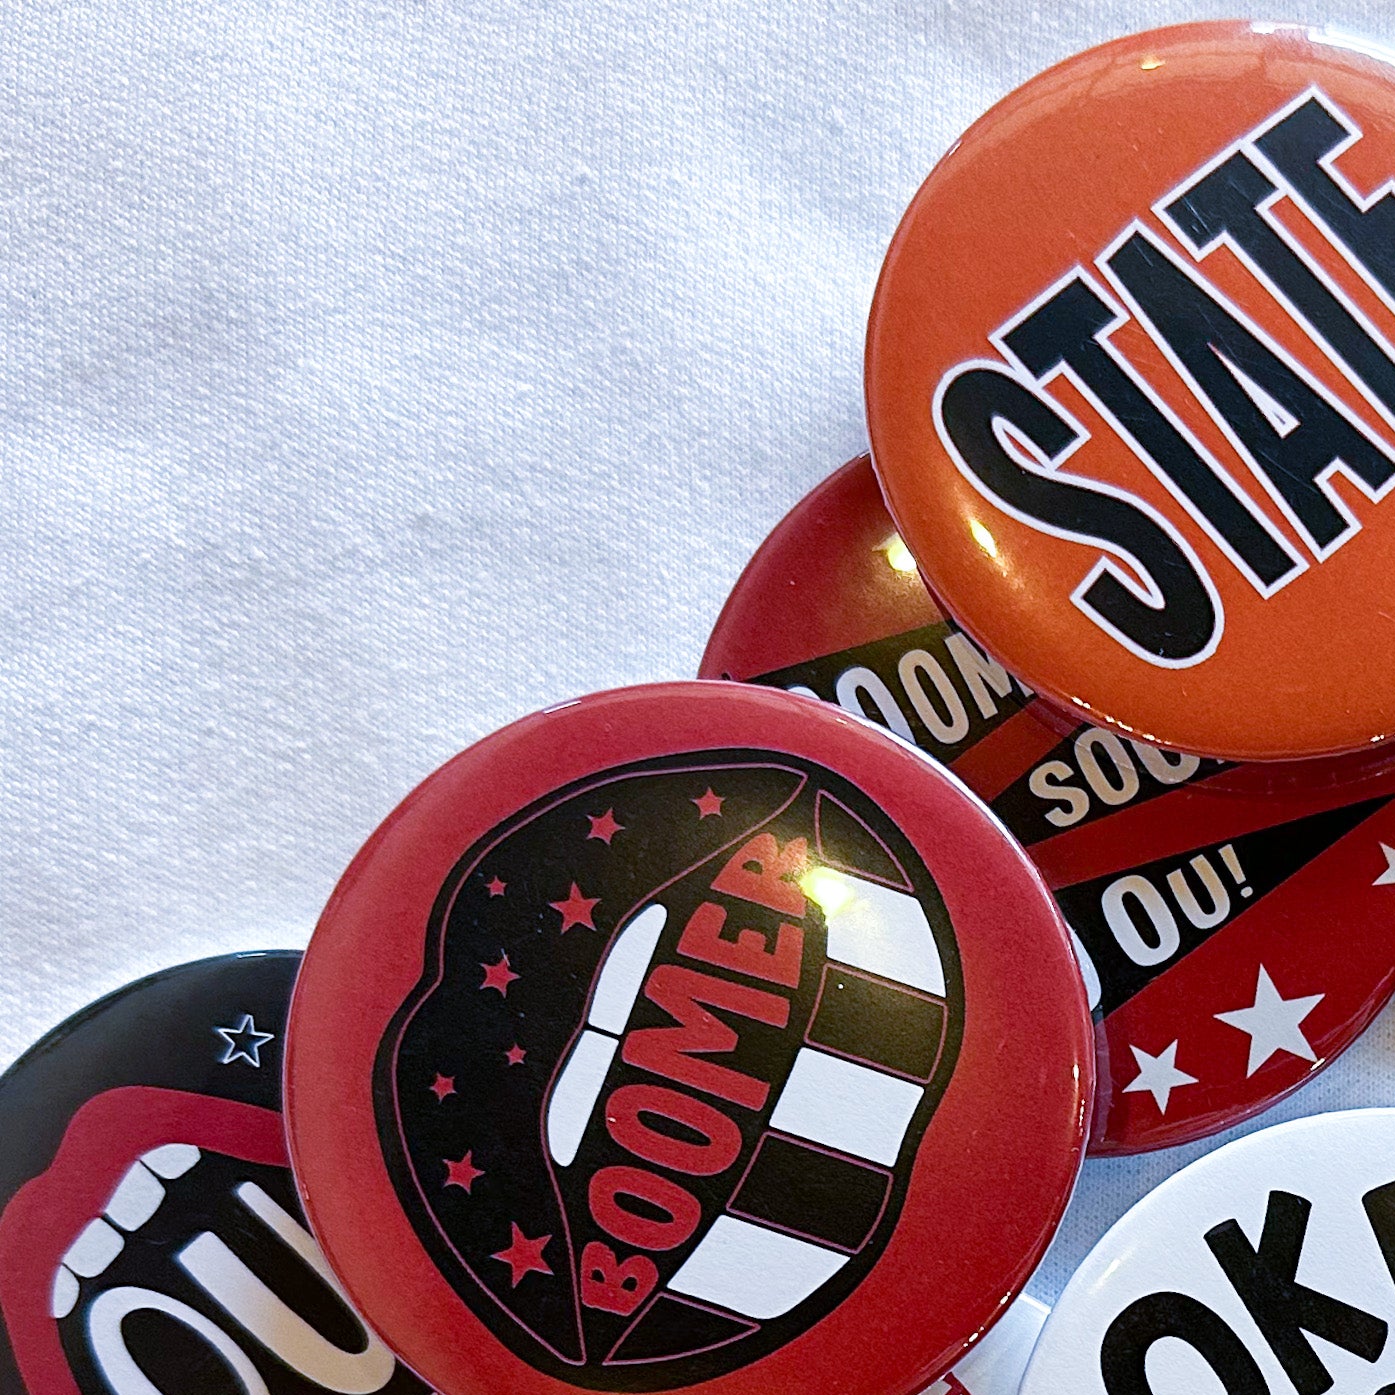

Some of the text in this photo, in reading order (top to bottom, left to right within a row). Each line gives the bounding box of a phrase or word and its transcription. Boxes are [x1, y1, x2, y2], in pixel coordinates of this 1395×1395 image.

[787, 632, 1034, 745] OOM
[1029, 727, 1225, 827] SOO
[1101, 844, 1254, 967] OU!
[580, 832, 808, 1318] BOOMER
